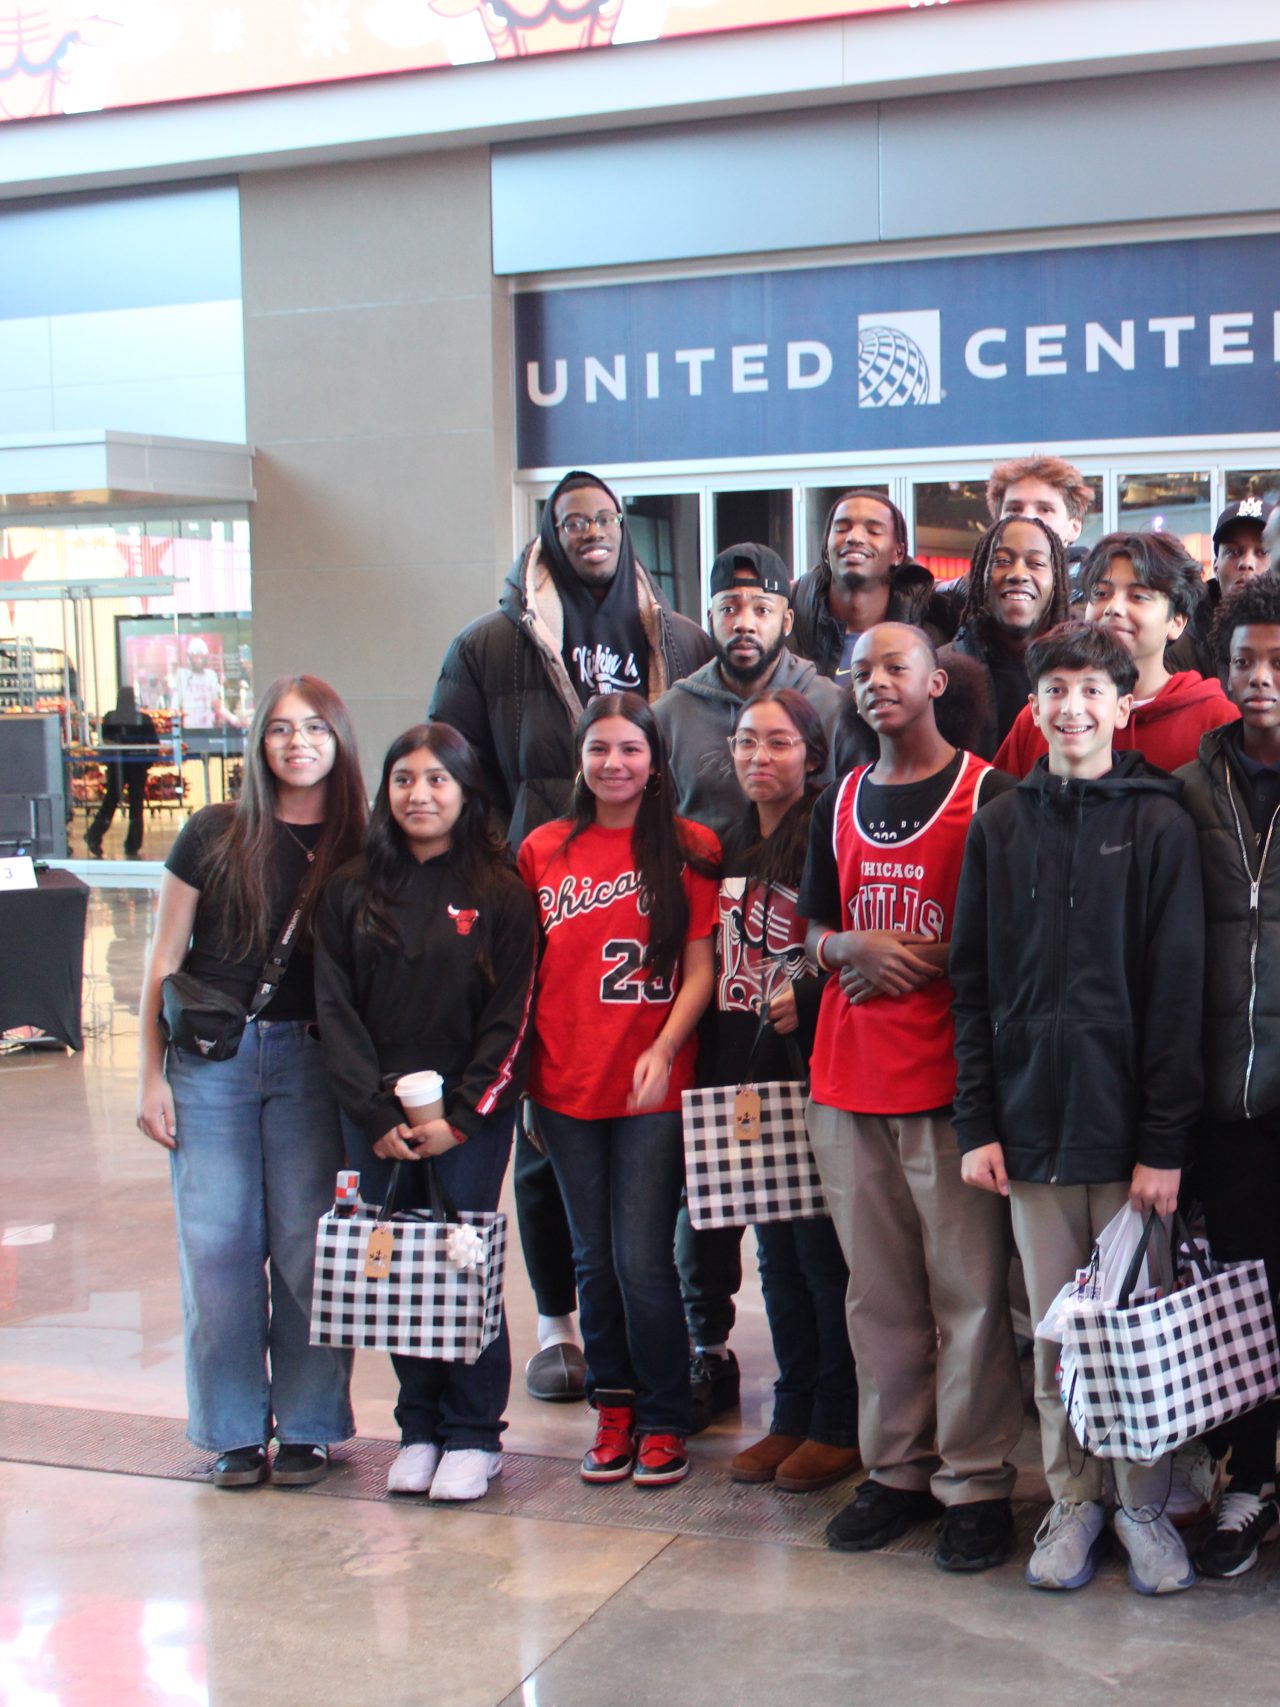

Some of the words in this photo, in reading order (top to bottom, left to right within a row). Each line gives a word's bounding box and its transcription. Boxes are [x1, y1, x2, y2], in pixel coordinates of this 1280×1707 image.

[527, 341, 833, 407] UNITED
[537, 868, 660, 935] Chica
[861, 861, 924, 880] HICAGO
[848, 884, 945, 944] ULLS
